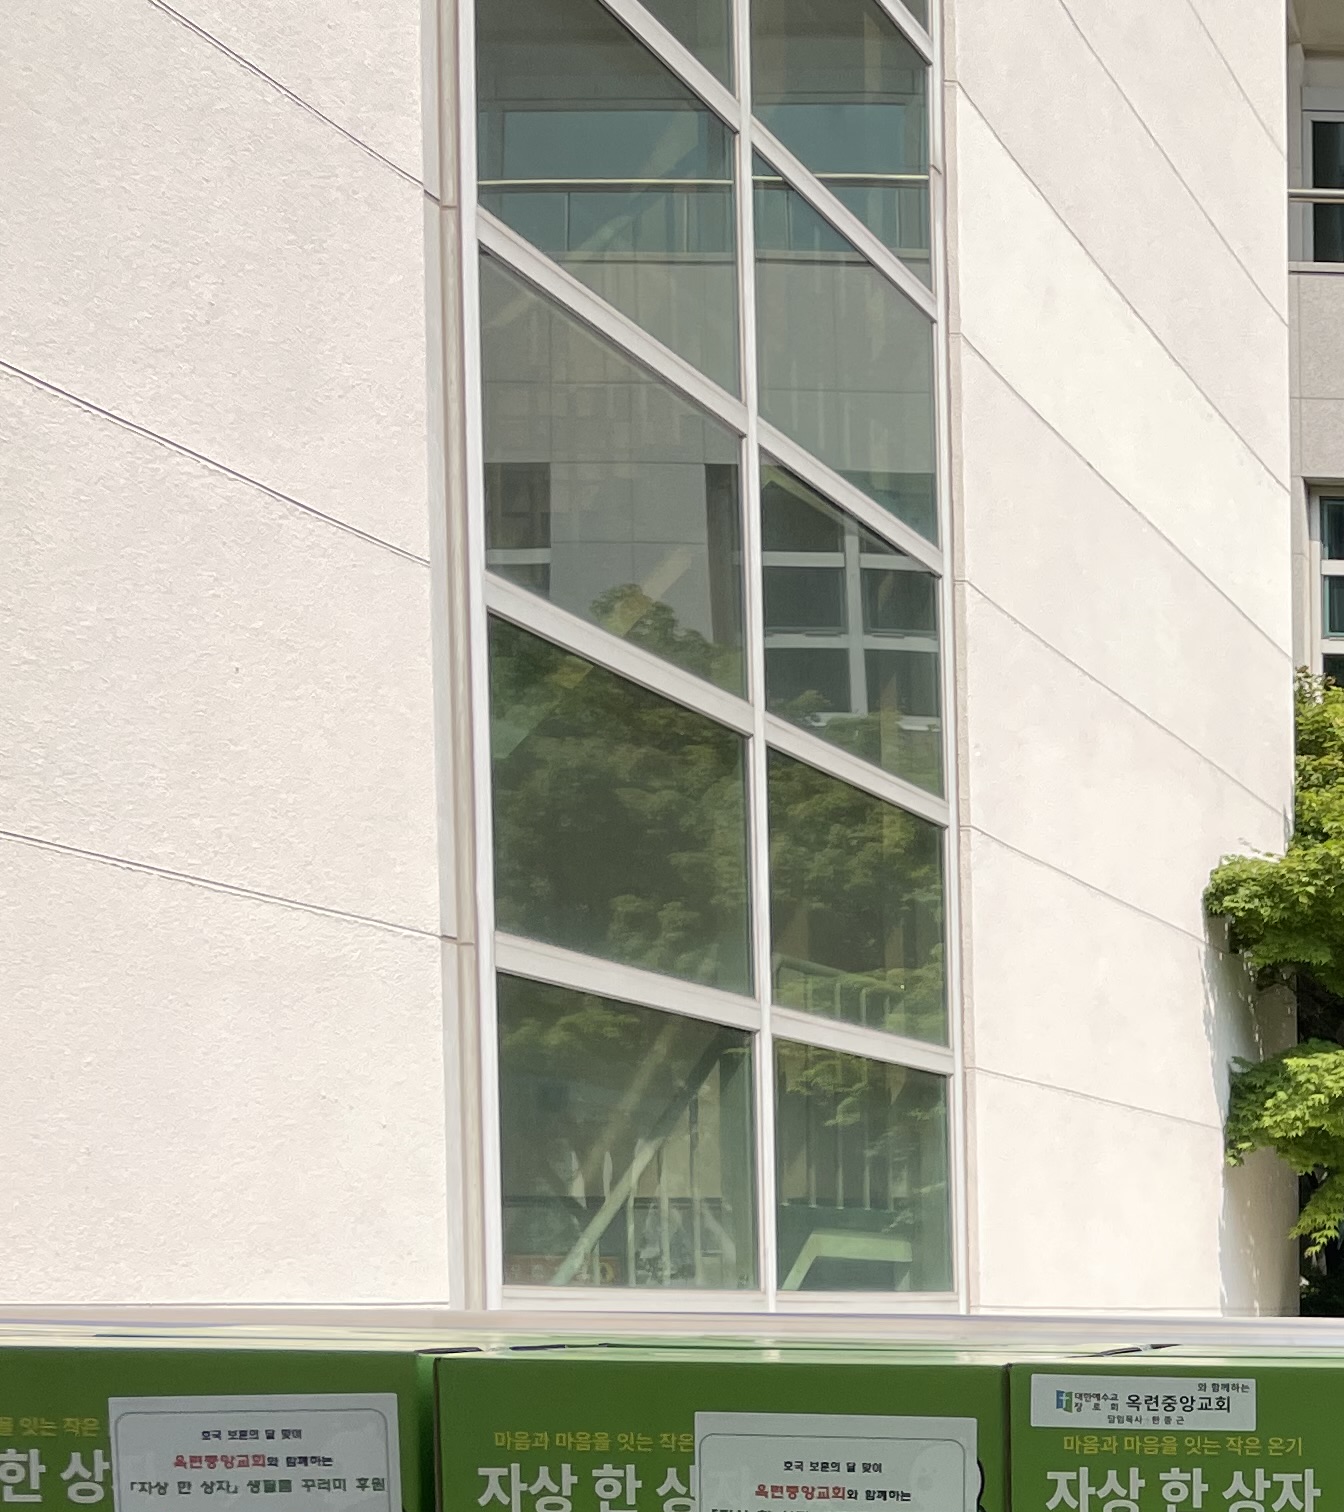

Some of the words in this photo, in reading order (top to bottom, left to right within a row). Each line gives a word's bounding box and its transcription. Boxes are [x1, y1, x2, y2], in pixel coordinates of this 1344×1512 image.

[1063, 1434, 1119, 1455] 마음과
[1123, 1435, 1179, 1456] 마음을
[1184, 1435, 1222, 1455] 잇는
[1225, 1435, 1262, 1456] 작은
[1267, 1436, 1302, 1457] 온기
